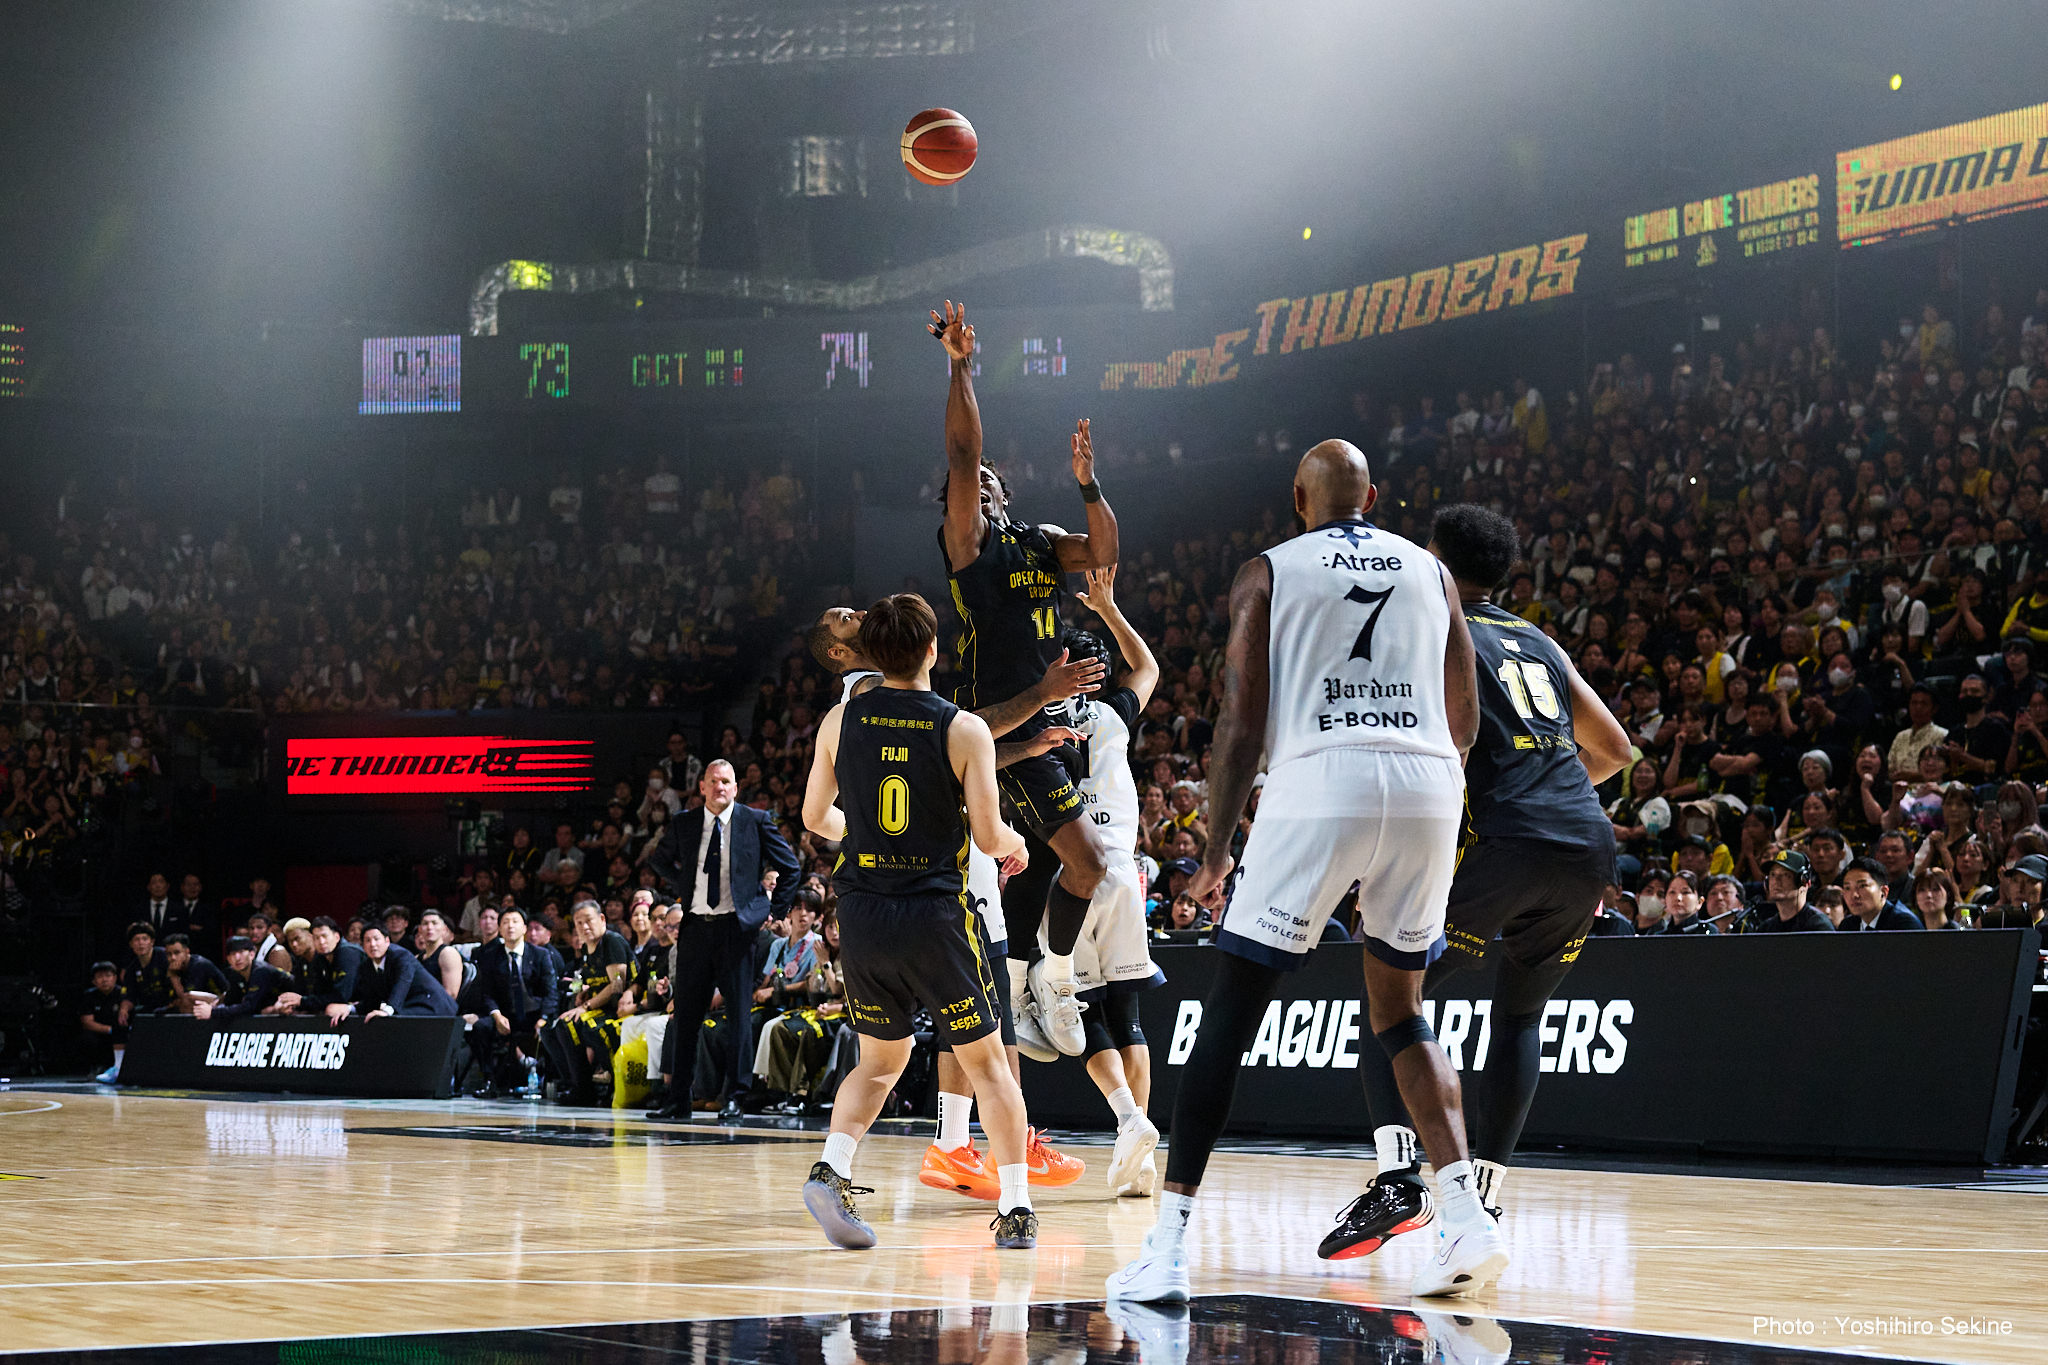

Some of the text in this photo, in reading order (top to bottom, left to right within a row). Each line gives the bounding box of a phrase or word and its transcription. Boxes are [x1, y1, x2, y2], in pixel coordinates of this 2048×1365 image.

[1253, 233, 1589, 356] THUNDERS
[520, 342, 569, 398] 73
[821, 332, 873, 389] 74
[1009, 569, 1057, 589] OPEN HOU
[1031, 606, 1056, 640] 14
[1343, 584, 1395, 663] 7
[1323, 677, 1413, 704] Pardon
[1497, 659, 1560, 720] 15
[1318, 711, 1418, 732] E-BOND
[881, 746, 909, 762] FUJII
[877, 774, 910, 836] 0
[878, 854, 929, 865] KANTO
[1256, 917, 1308, 942] FUYO LEASE
[1292, 916, 1310, 927] BAN
[270, 1033, 350, 1070] PARTNERS
[1167, 999, 1361, 1069] BAGUE
